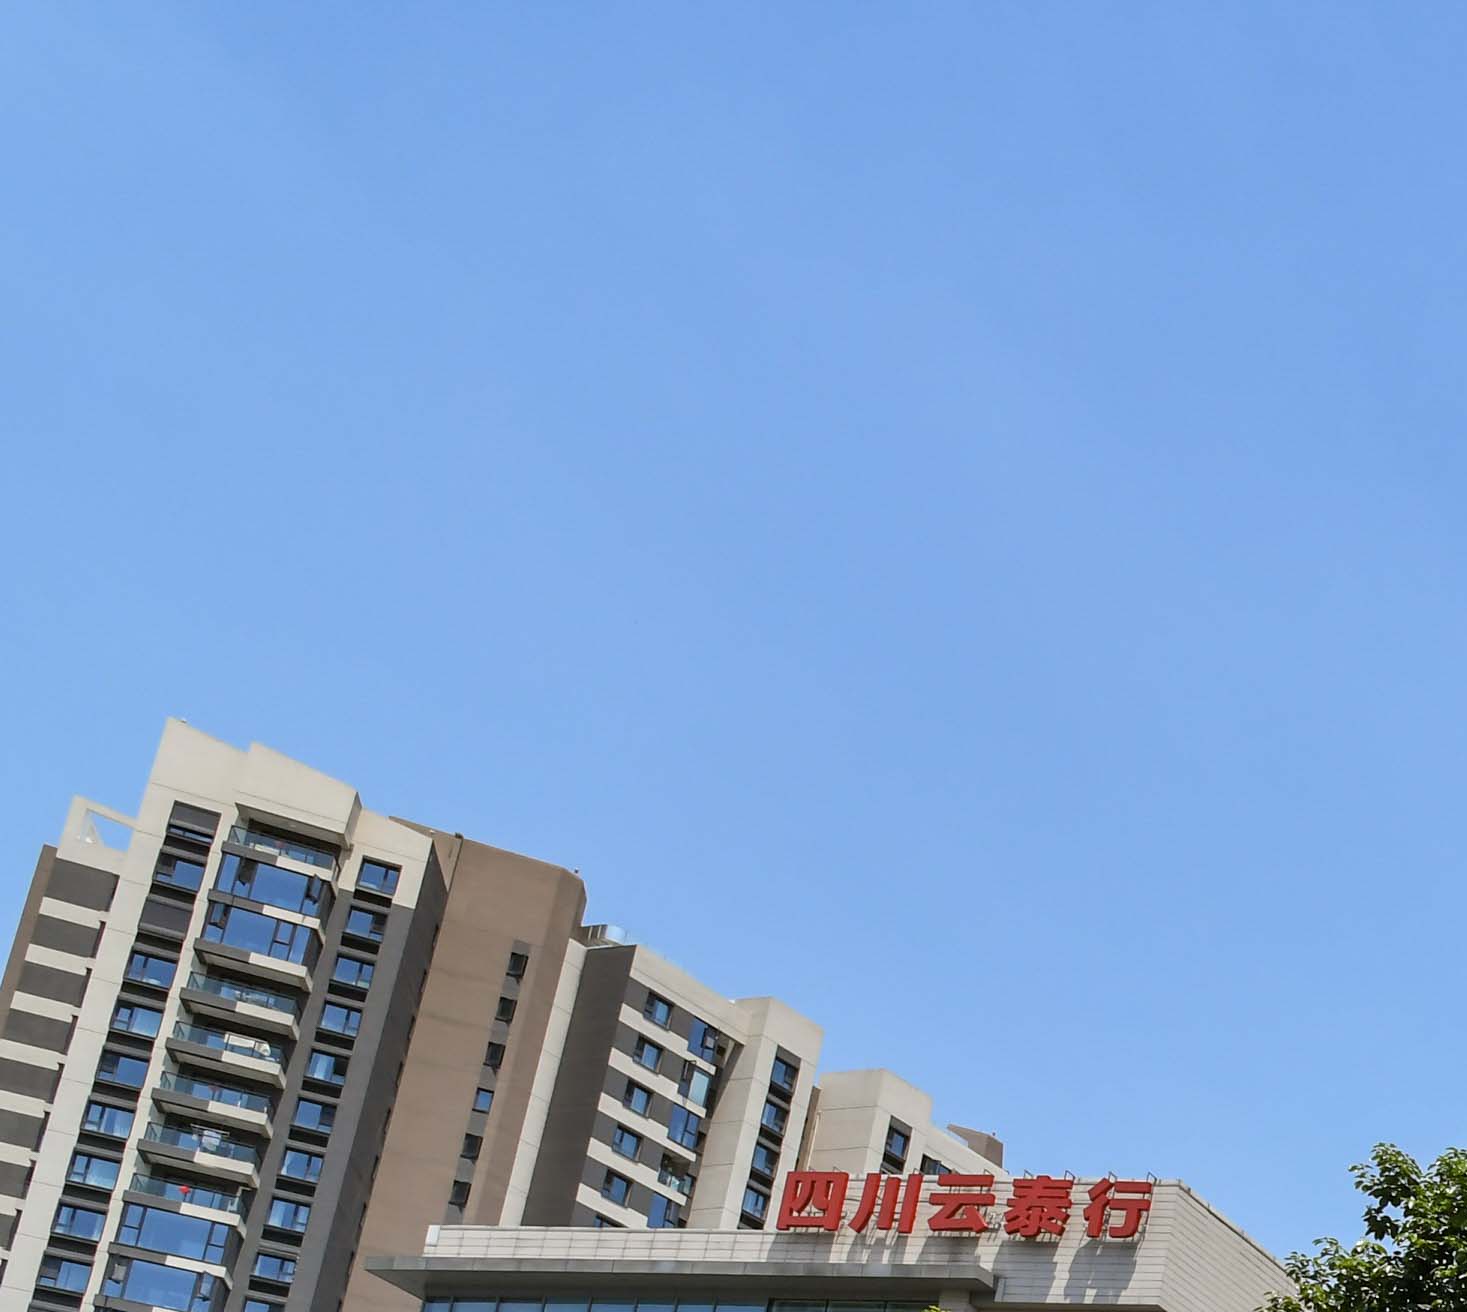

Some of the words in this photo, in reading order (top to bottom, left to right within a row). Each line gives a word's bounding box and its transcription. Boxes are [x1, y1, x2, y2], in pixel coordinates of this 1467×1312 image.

[776, 1171, 1152, 1238] 四川云泰行
